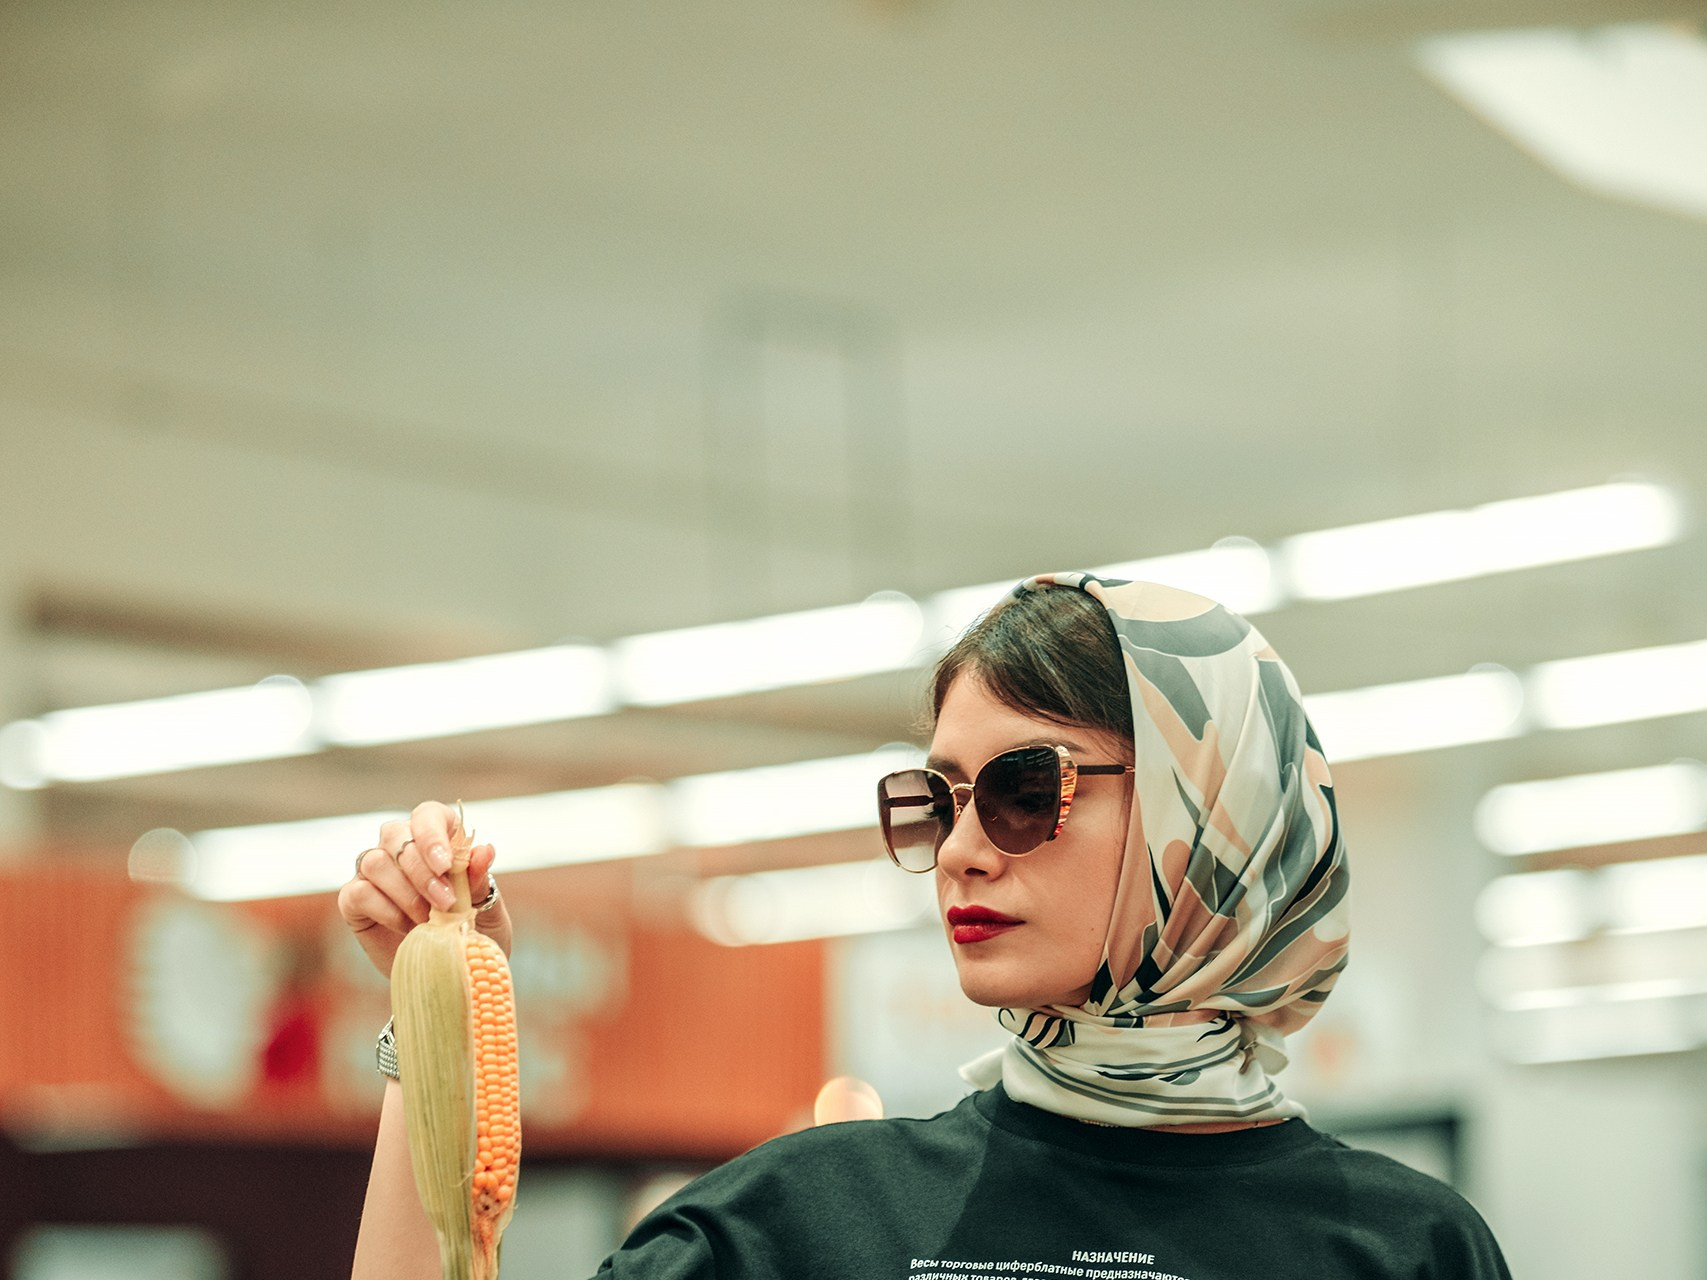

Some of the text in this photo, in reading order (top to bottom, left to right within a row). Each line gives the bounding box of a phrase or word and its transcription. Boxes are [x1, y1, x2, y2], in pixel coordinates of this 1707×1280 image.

[1072, 1250, 1155, 1265] НАЗНАЧЕНИЕ
[910, 1258, 939, 1269] Весы
[941, 1260, 994, 1271] торговые
[995, 1260, 1083, 1277] циферблатные
